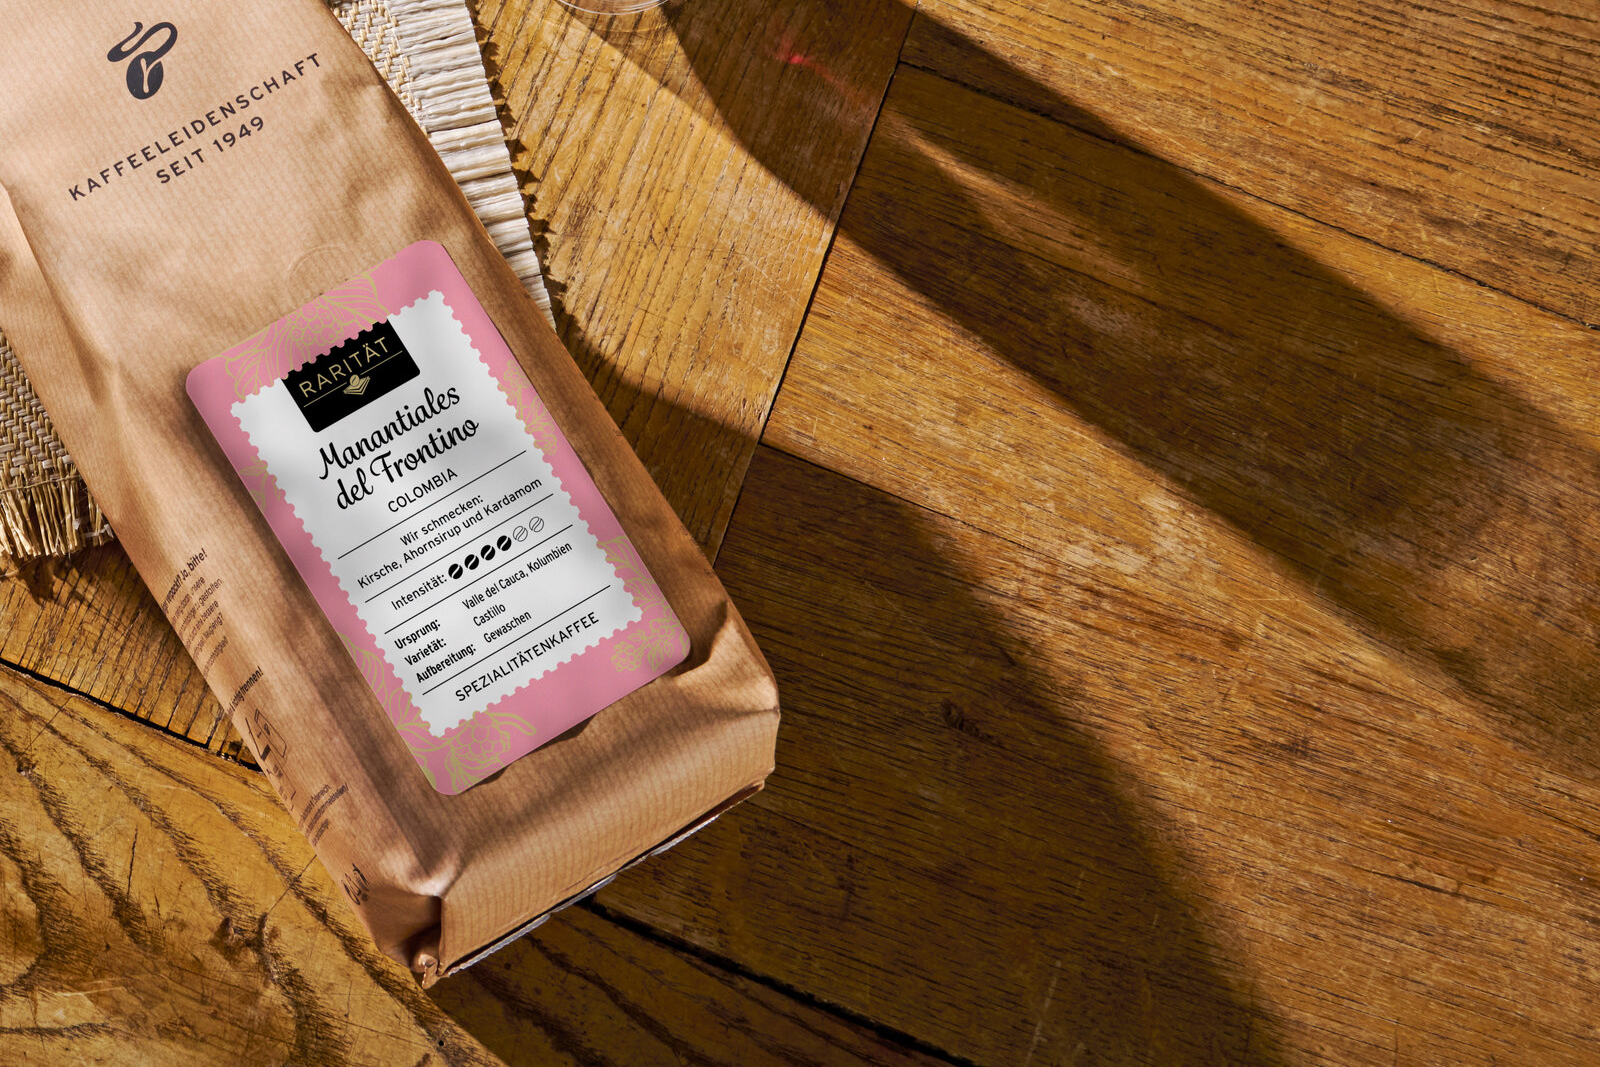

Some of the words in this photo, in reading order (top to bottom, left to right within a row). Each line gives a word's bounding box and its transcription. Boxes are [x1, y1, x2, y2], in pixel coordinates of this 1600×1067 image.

[68, 52, 321, 201] KAFFEELEIDENSCHAFT
[155, 148, 205, 184] SEIT
[212, 116, 264, 153] 1949
[298, 336, 389, 398] RARITÄT
[319, 386, 460, 480] Manantiales
[336, 467, 374, 510] del
[369, 419, 480, 483] Frontino
[387, 467, 458, 512] COLOMBIA
[400, 531, 419, 546] Wir
[421, 494, 484, 536] schmecken:
[186, 547, 208, 572] bitte!
[357, 560, 402, 589] Kirsche,
[402, 527, 462, 564] Ahornsirup
[462, 511, 484, 529] und
[483, 477, 542, 516] Kardamom
[391, 574, 447, 610] Intensität:
[394, 619, 441, 650] Ursprung:
[462, 592, 485, 610] Valle
[485, 584, 500, 599] del
[499, 569, 529, 590] Cauca,
[526, 542, 573, 573] Kolumbien
[404, 637, 447, 667] Varietät:
[472, 603, 506, 627] Castillo
[415, 643, 476, 684] Aufbereitung:
[483, 610, 532, 644] Gewaschen
[455, 611, 599, 702] SPEZIALITÄTENKAFFEE
